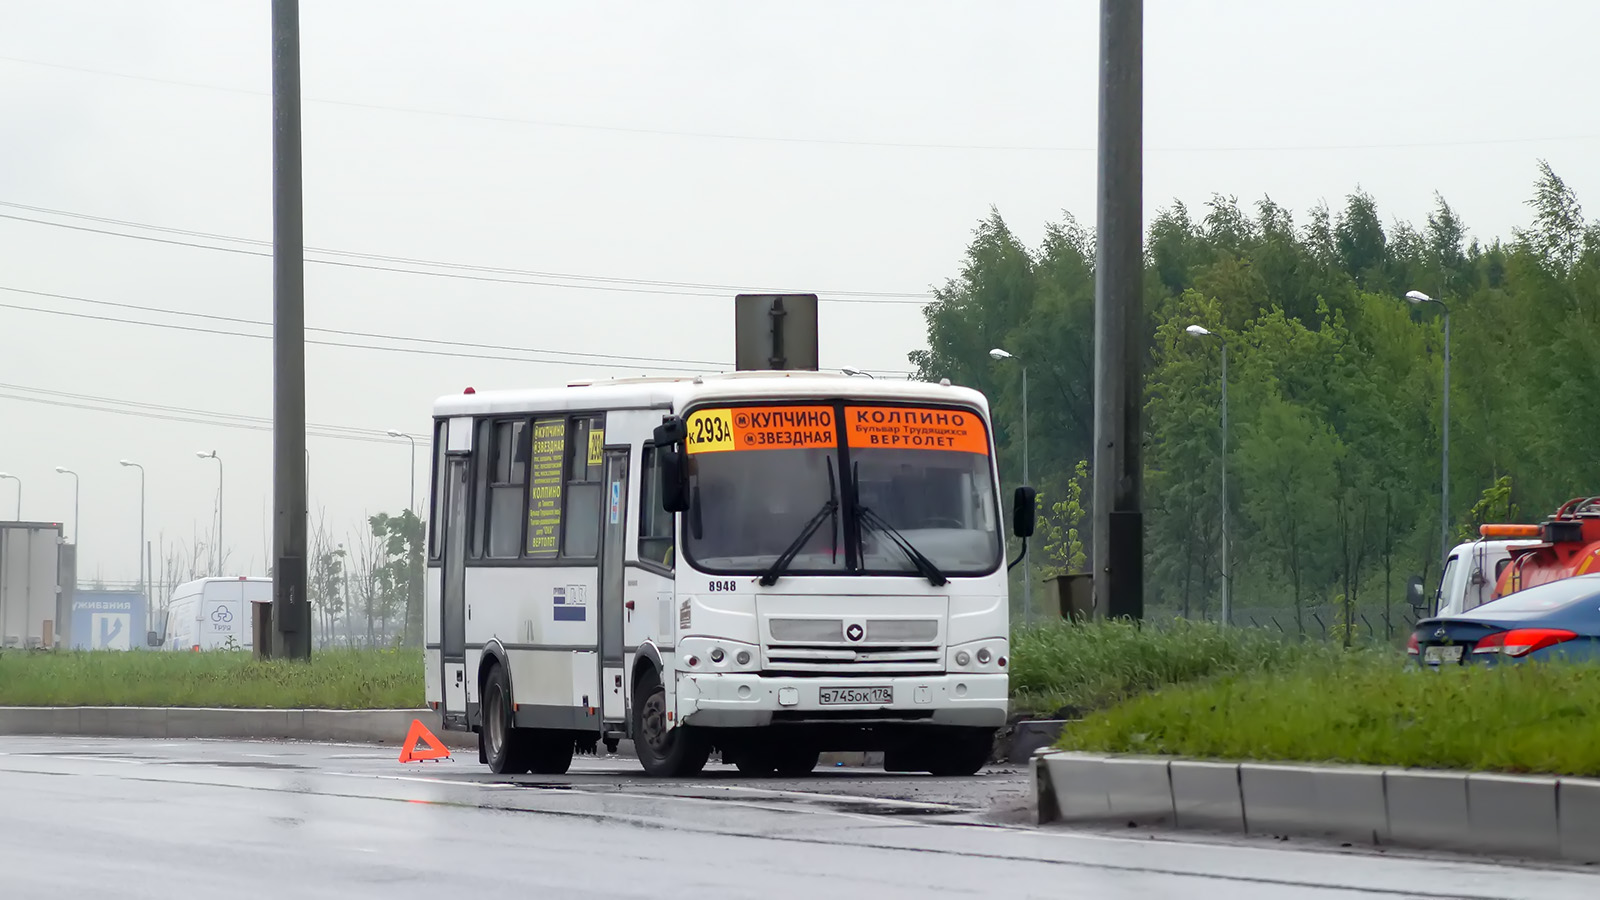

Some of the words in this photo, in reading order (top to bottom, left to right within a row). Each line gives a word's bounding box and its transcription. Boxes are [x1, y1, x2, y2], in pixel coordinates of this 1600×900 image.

[751, 411, 831, 428] КУПЧИНО
[857, 410, 964, 427] КОЛПИНО
[856, 424, 900, 434] Бульвар
[903, 425, 967, 436] Трудящихся
[757, 431, 832, 446] ЗВЕЗДНАЯ
[870, 435, 954, 447] ВЕРТОЛЕТ
[533, 486, 560, 499] КОЛПИНО
[532, 536, 556, 548] ВЕРТОЛЕТ
[708, 580, 736, 592] 8948
[872, 688, 889, 699] 178
